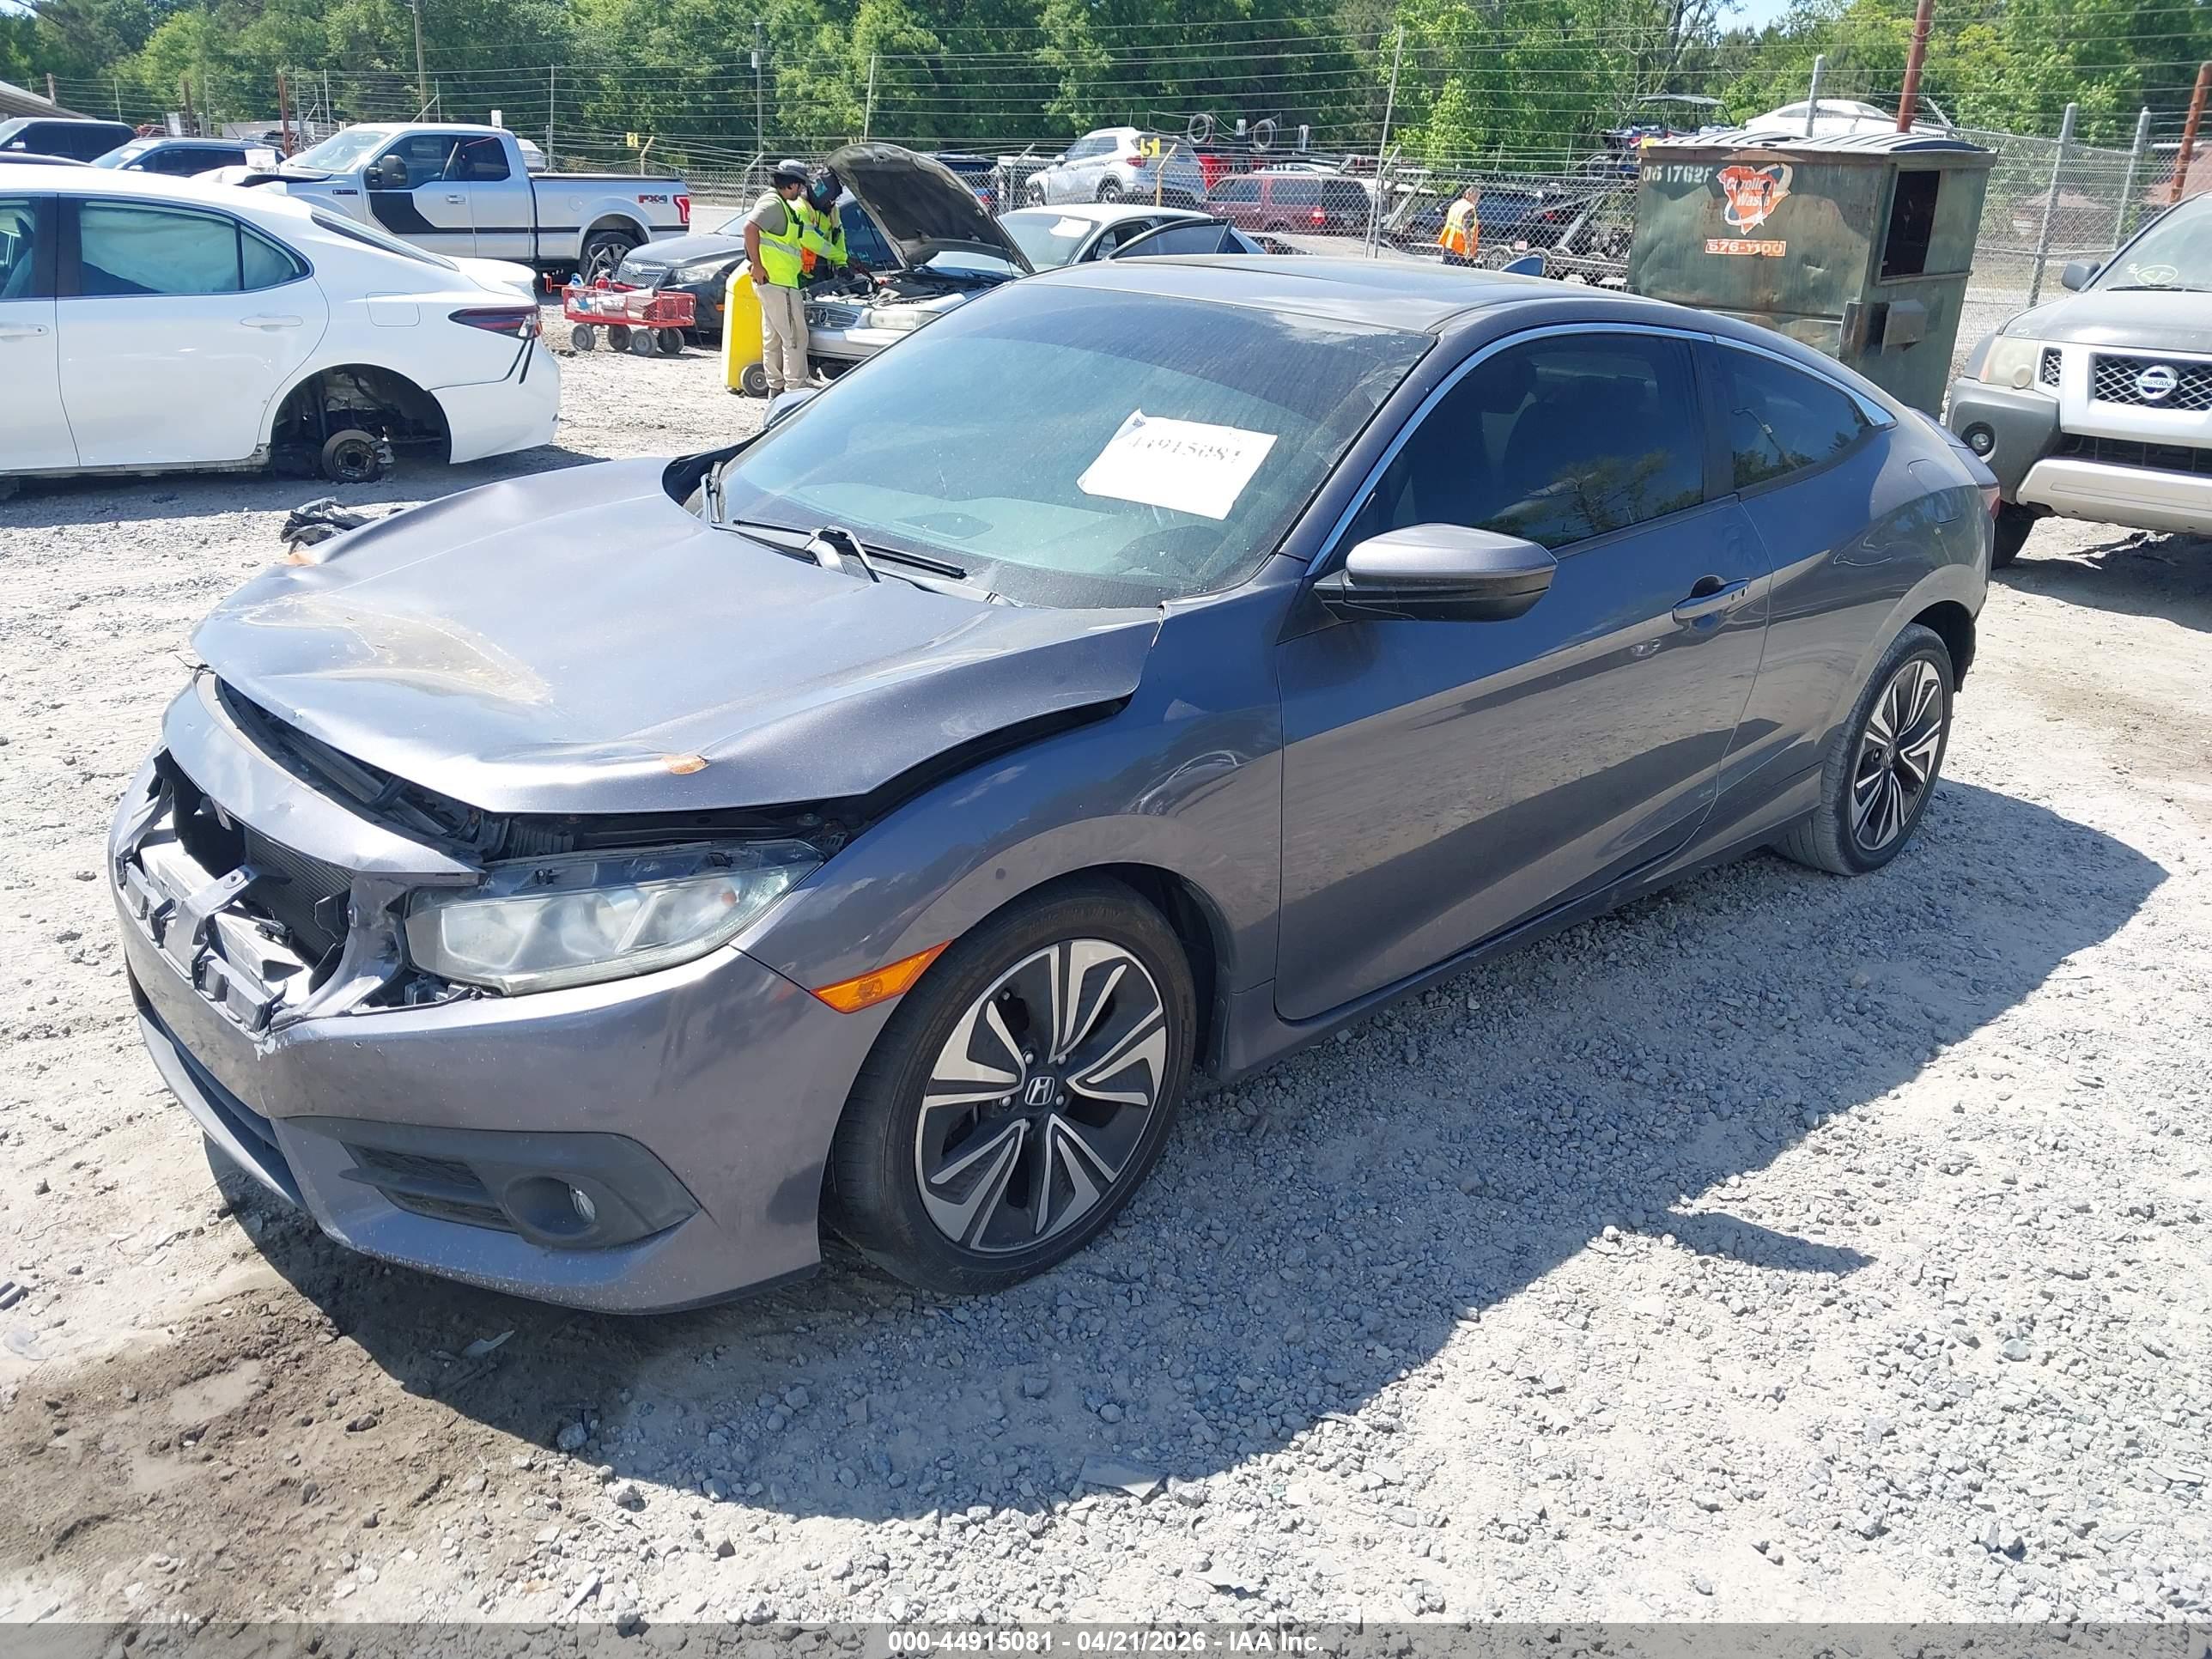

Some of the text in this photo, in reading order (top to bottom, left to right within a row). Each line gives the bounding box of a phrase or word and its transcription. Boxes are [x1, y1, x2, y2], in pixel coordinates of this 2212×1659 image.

[638, 194, 668, 204] FX4
[1736, 192, 1771, 207] Wase
[2139, 379, 2172, 387] NISSAN
